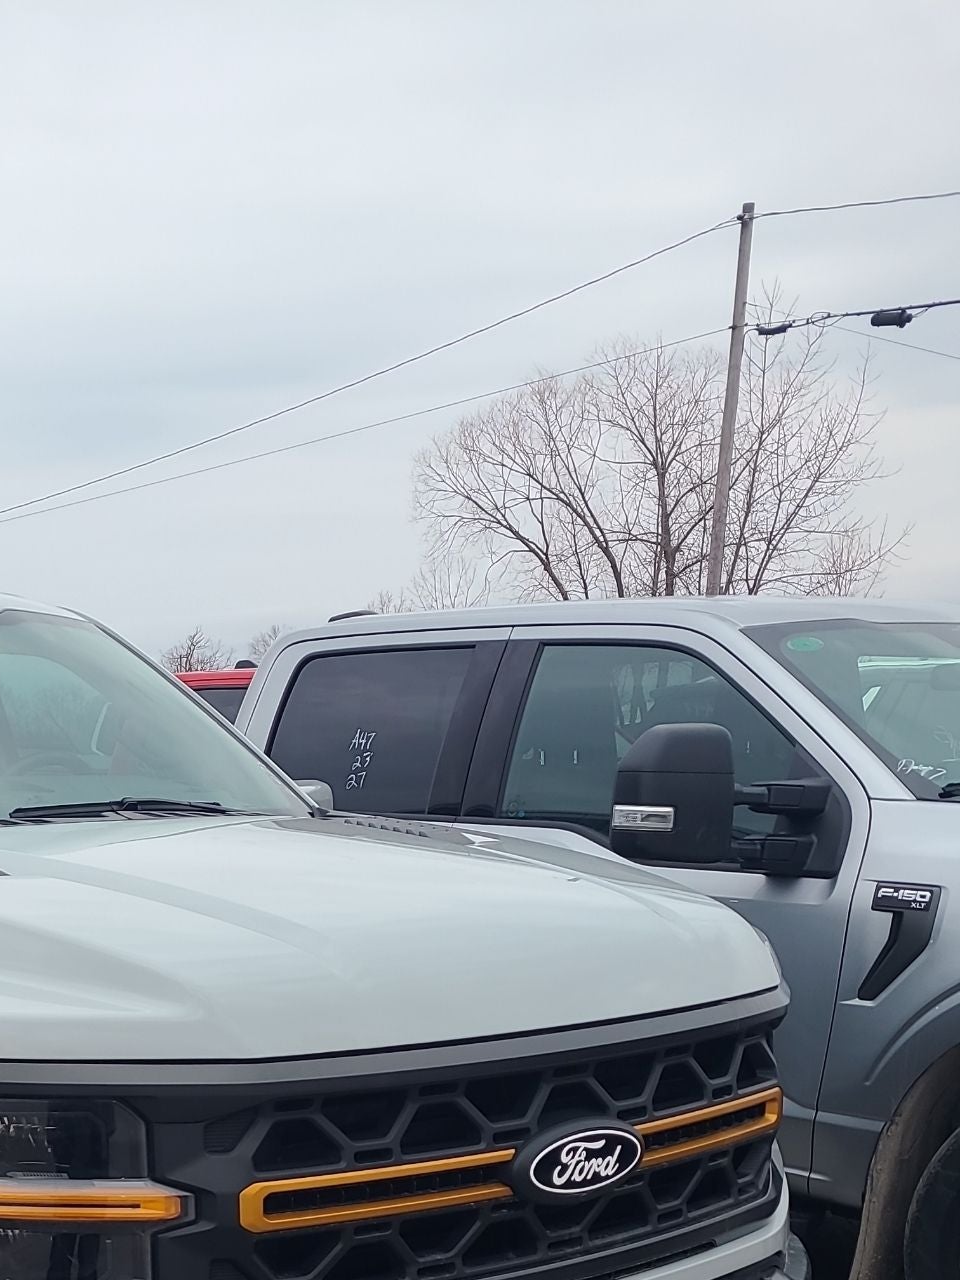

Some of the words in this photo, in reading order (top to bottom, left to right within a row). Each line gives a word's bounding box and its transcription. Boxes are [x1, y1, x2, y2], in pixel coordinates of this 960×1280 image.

[349, 728, 376, 751] A47
[346, 771, 366, 790] 27
[877, 887, 931, 902] F-150
[552, 1139, 622, 1186] Ford
